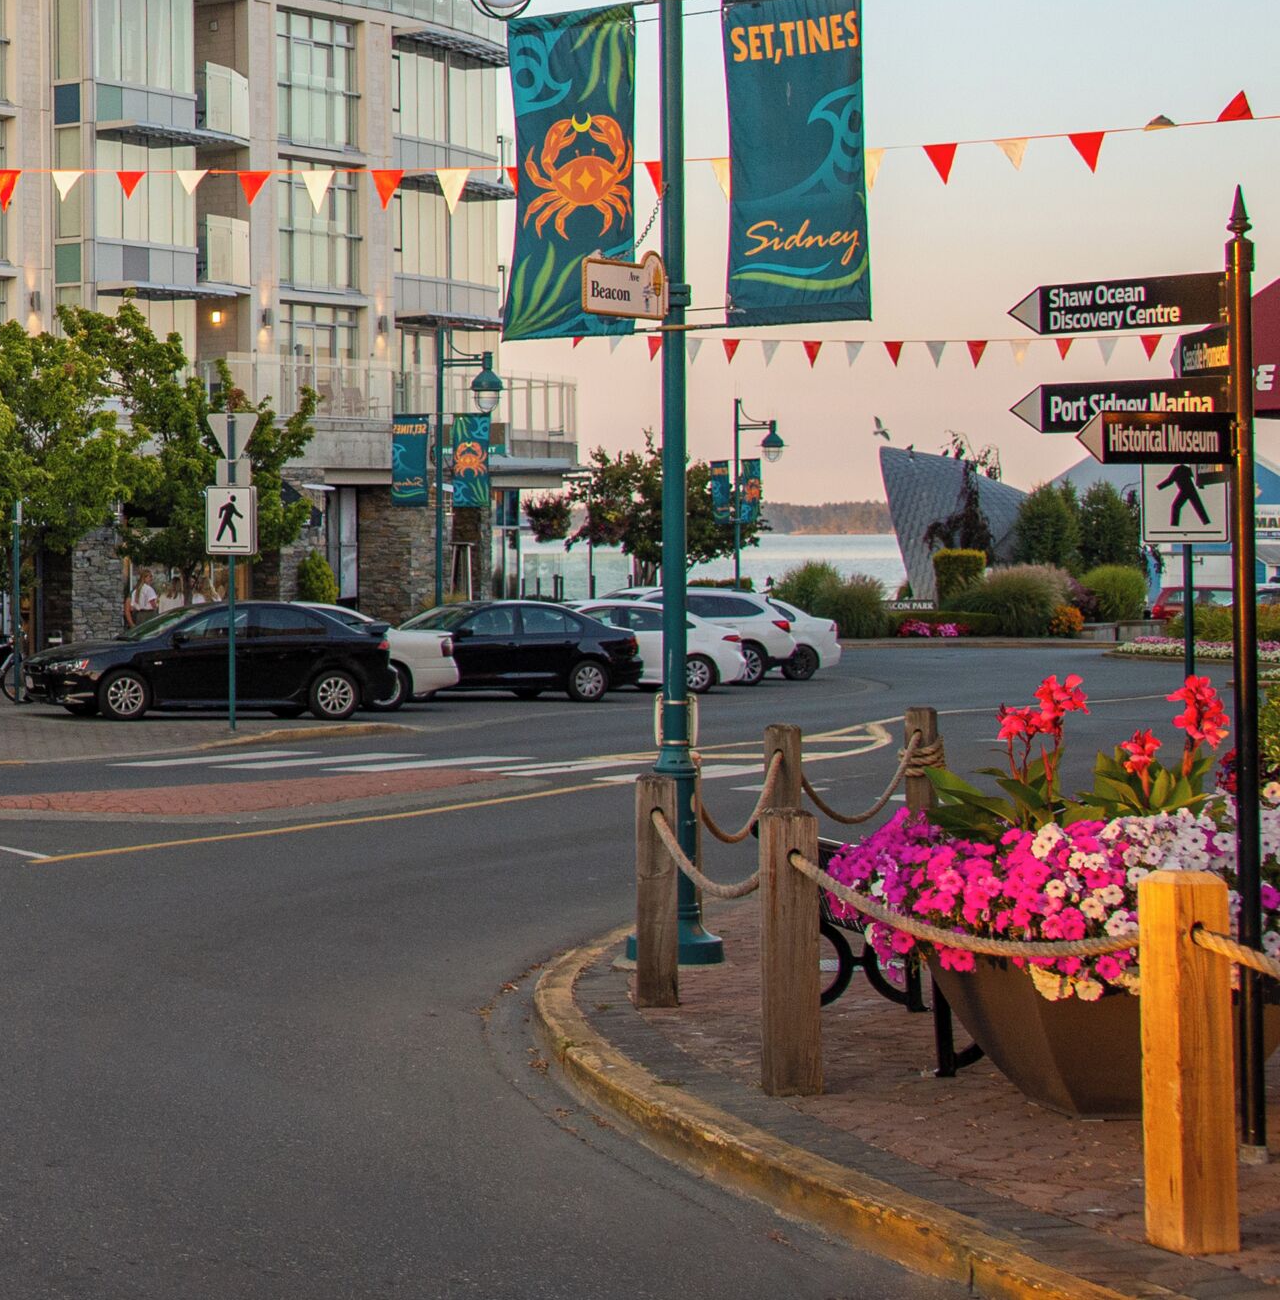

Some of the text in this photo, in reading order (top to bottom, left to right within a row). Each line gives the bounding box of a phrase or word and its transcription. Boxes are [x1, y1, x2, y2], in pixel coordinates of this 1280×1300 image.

[730, 10, 860, 64] SET,TINES
[744, 219, 860, 266] Sidney
[629, 271, 640, 282] Ave
[591, 280, 631, 302] Beacon
[1049, 285, 1145, 308] Shaw Ocean
[1049, 304, 1181, 330] Discovery Centre
[1050, 395, 1087, 422] Port
[1149, 391, 1214, 412] Marina
[1108, 423, 1219, 453] Historical Museum
[912, 601, 934, 610] PARK
